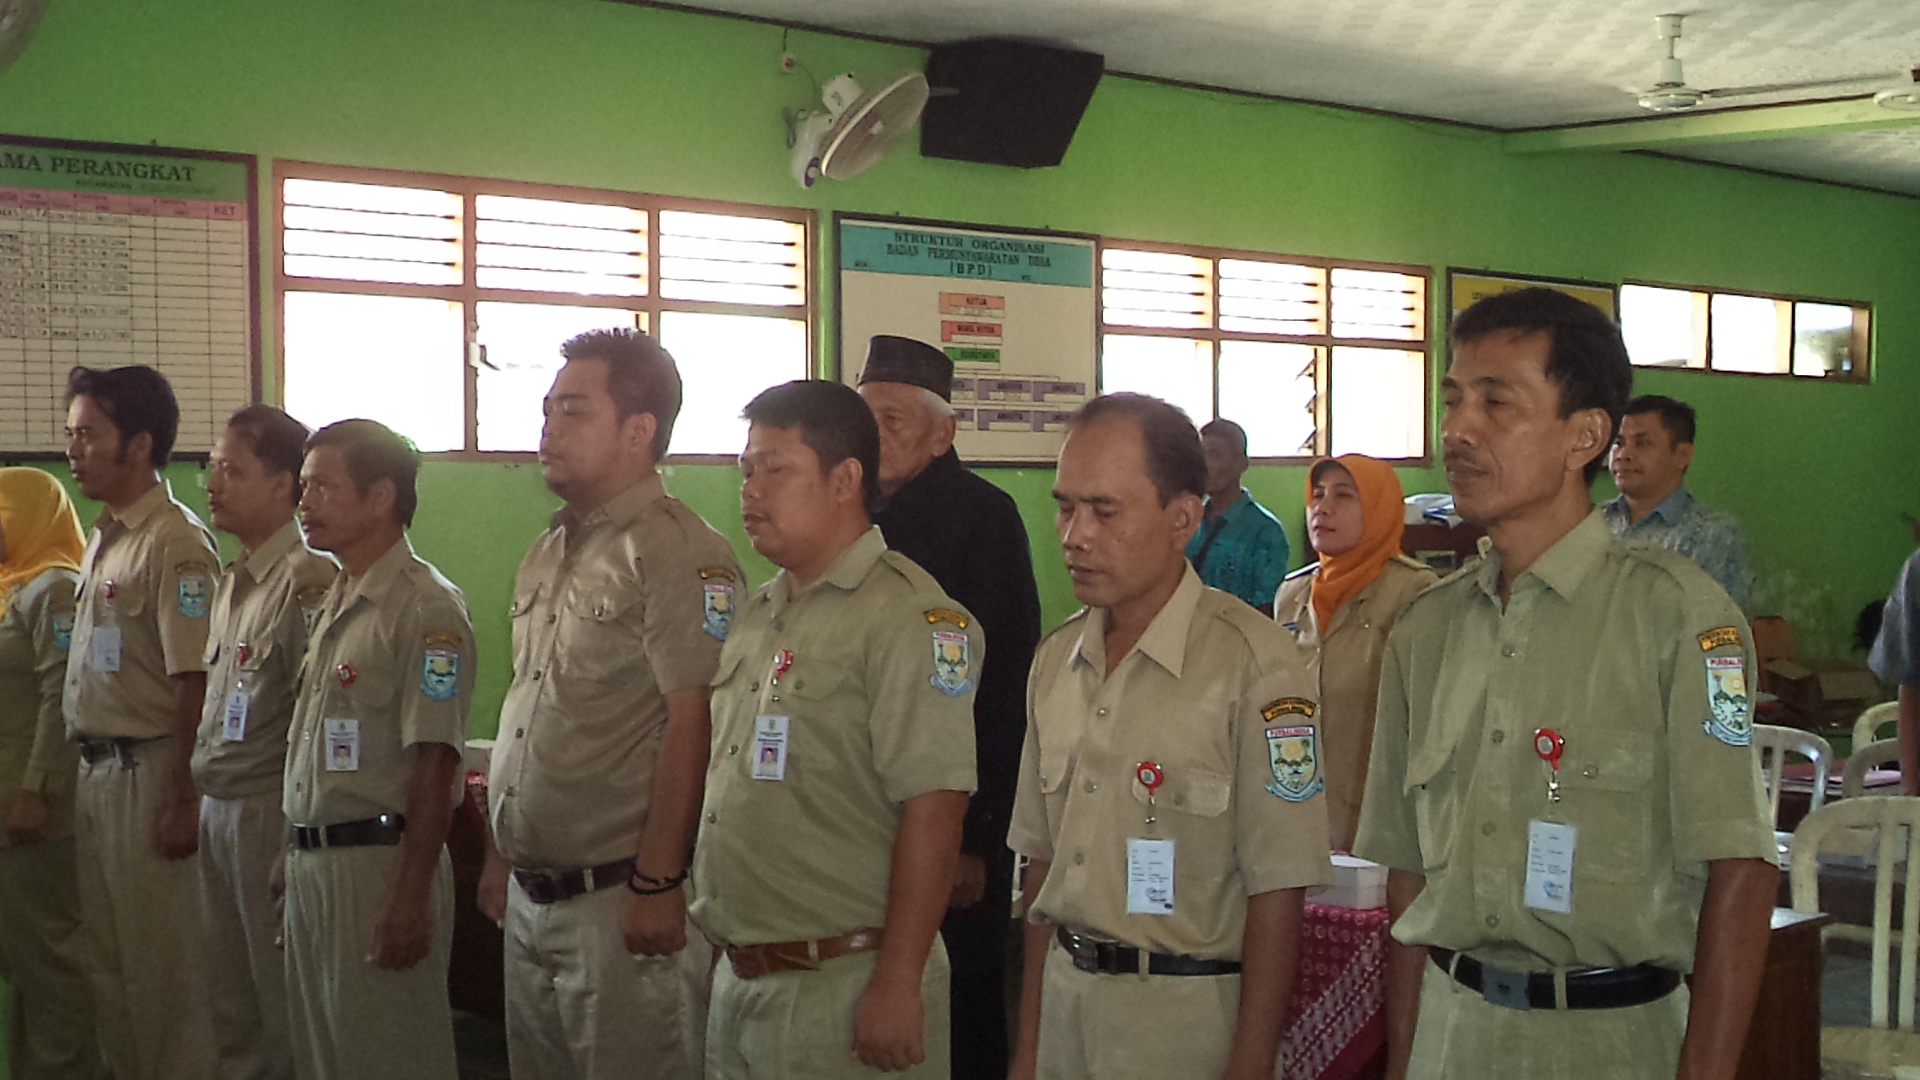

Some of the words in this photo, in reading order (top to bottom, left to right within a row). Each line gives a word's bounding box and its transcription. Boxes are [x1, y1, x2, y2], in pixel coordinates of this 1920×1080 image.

[0, 152, 42, 171] MA
[51, 157, 196, 182] PERANGKAT
[213, 205, 235, 216] KET
[886, 243, 919, 257] BADAN
[894, 231, 964, 249] STRUKTUR
[971, 238, 1045, 254] ORGANISASI
